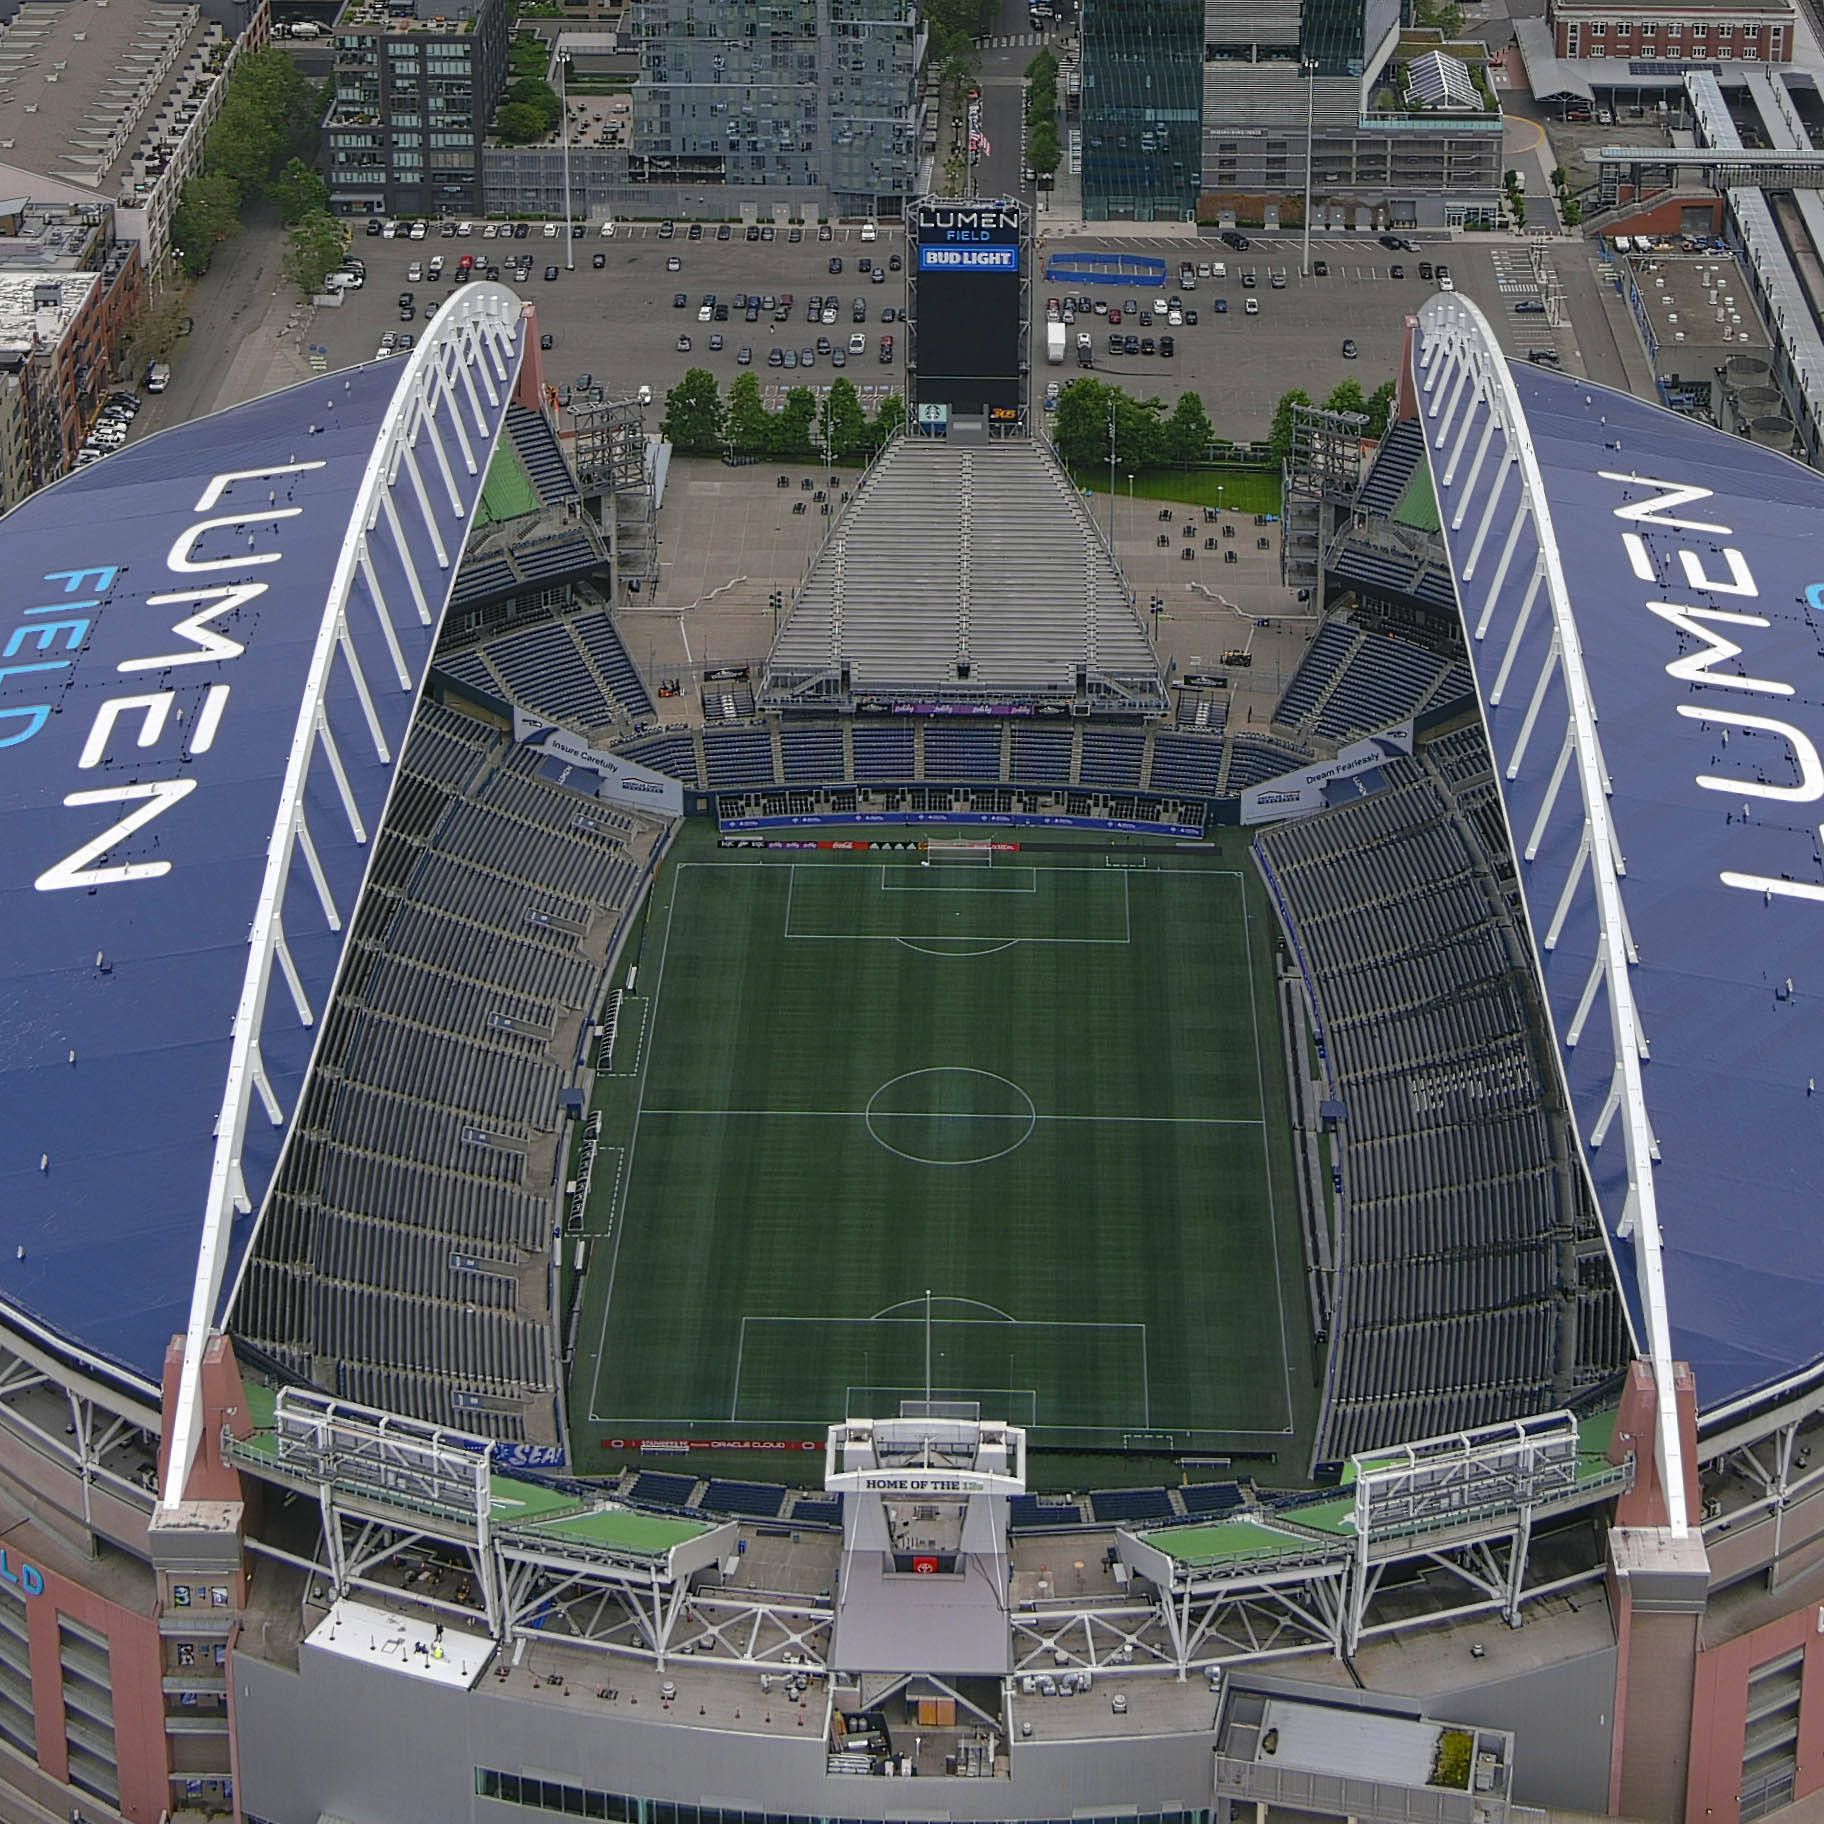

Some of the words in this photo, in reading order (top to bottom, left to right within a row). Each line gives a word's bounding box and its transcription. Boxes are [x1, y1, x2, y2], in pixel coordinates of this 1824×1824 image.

[920, 211, 1018, 230] LUMEN
[947, 230, 991, 241] FIELD
[926, 251, 960, 266] BUD
[962, 251, 1012, 266] LIGHT
[34, 460, 327, 893] LUMEN
[552, 739, 580, 758] Insure
[580, 750, 619, 773] Carefully
[1306, 768, 1336, 785] Dream
[1336, 752, 1380, 778] Fearlessly
[509, 1445, 562, 1466] SEA!
[866, 1479, 908, 1489] HOME
[911, 1480, 928, 1490] OF
[931, 1480, 960, 1490] THE
